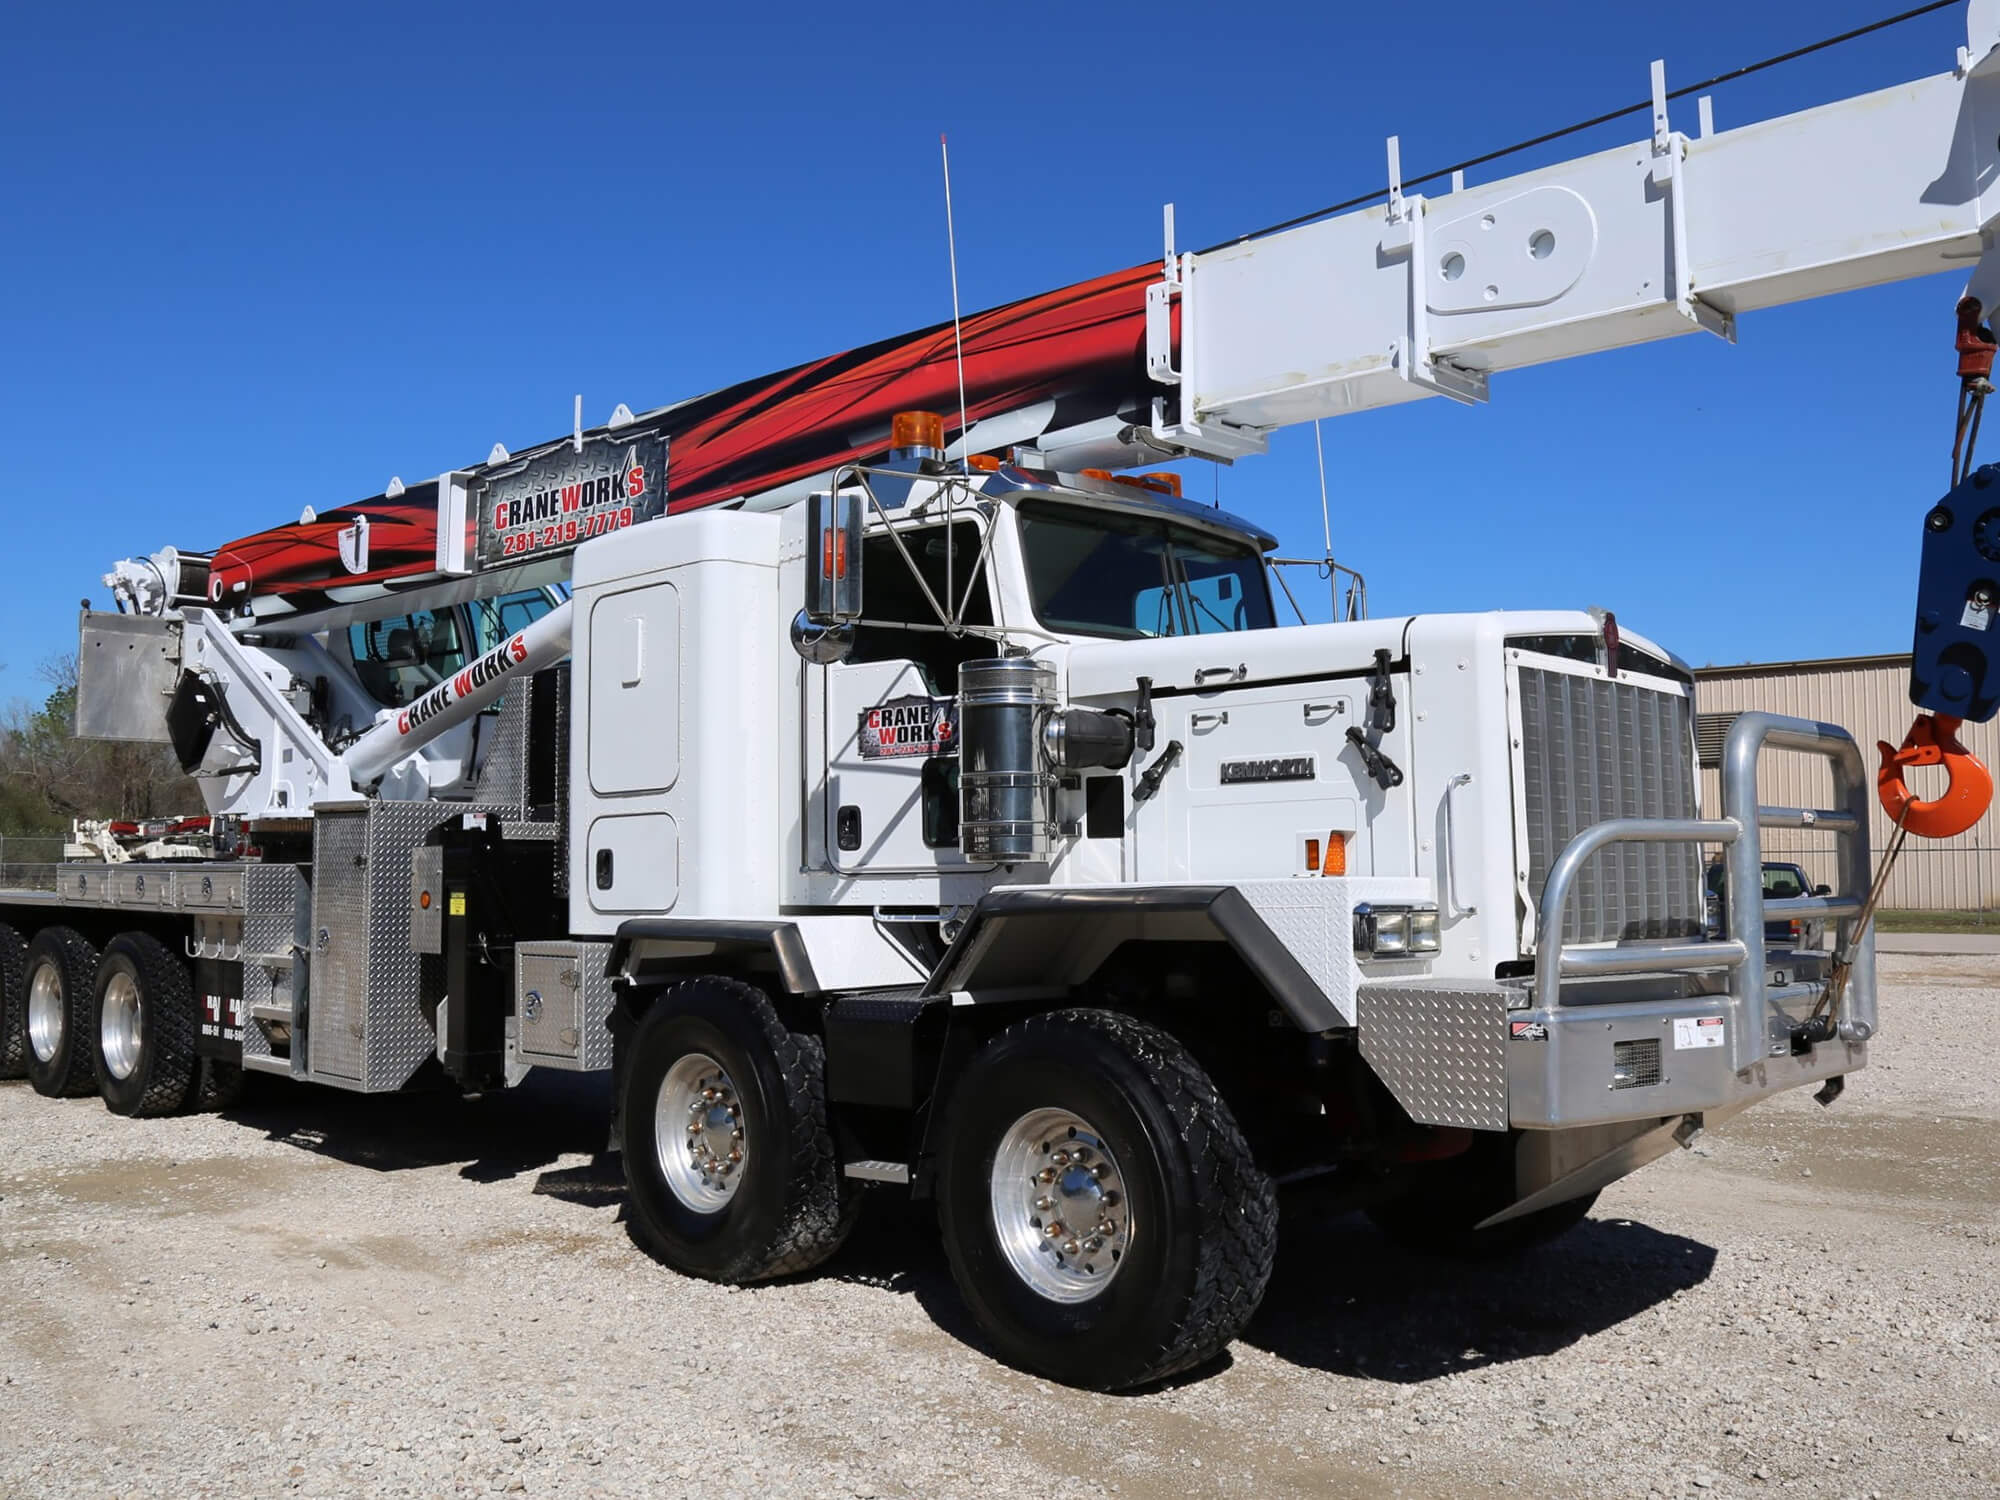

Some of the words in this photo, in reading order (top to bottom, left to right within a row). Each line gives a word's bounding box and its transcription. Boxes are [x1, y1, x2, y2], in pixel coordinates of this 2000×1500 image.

[503, 507, 632, 555] 281-219-7779
[398, 684, 452, 735] CRANE
[454, 635, 528, 698] WORKS
[867, 705, 929, 729] CRANE
[879, 708, 952, 745] WORKS
[1220, 758, 1314, 782] KENWORTH
